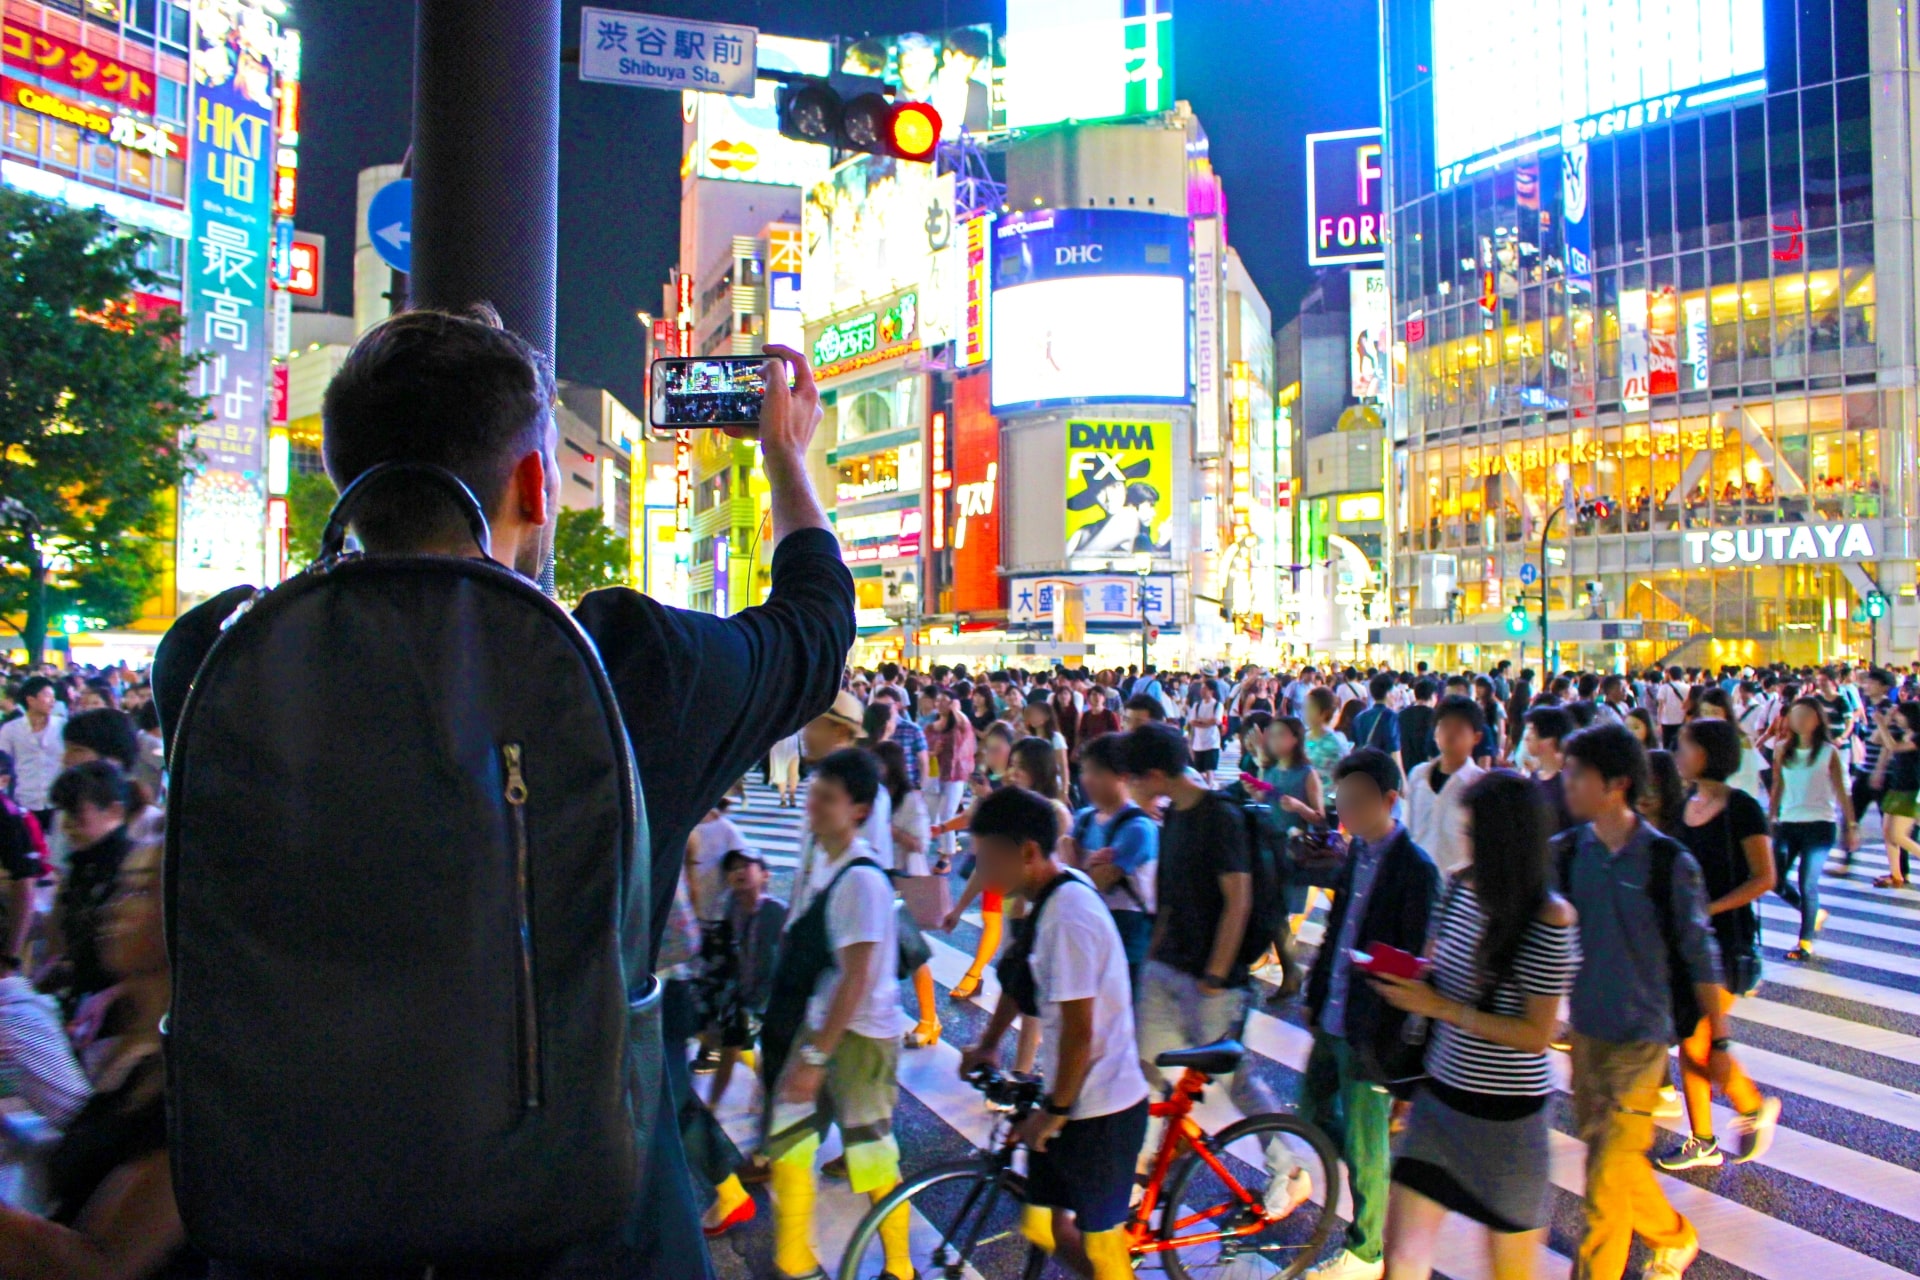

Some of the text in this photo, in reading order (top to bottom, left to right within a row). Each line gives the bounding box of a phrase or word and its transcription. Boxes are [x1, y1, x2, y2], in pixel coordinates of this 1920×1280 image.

[3, 25, 151, 100] コンタクト
[597, 20, 743, 66] 渋谷駅前
[619, 58, 726, 85] Shibuya Sta.
[197, 96, 269, 161] HKT
[207, 152, 255, 204] 48
[1055, 243, 1103, 266] DHC
[1199, 331, 1212, 393] neon
[1069, 423, 1154, 450] DMM
[1068, 451, 1126, 482] FX
[1468, 440, 1603, 479] STARBUCKS
[1686, 523, 1874, 564] TSUTAYA
[1018, 583, 1163, 613] 大盛書店
